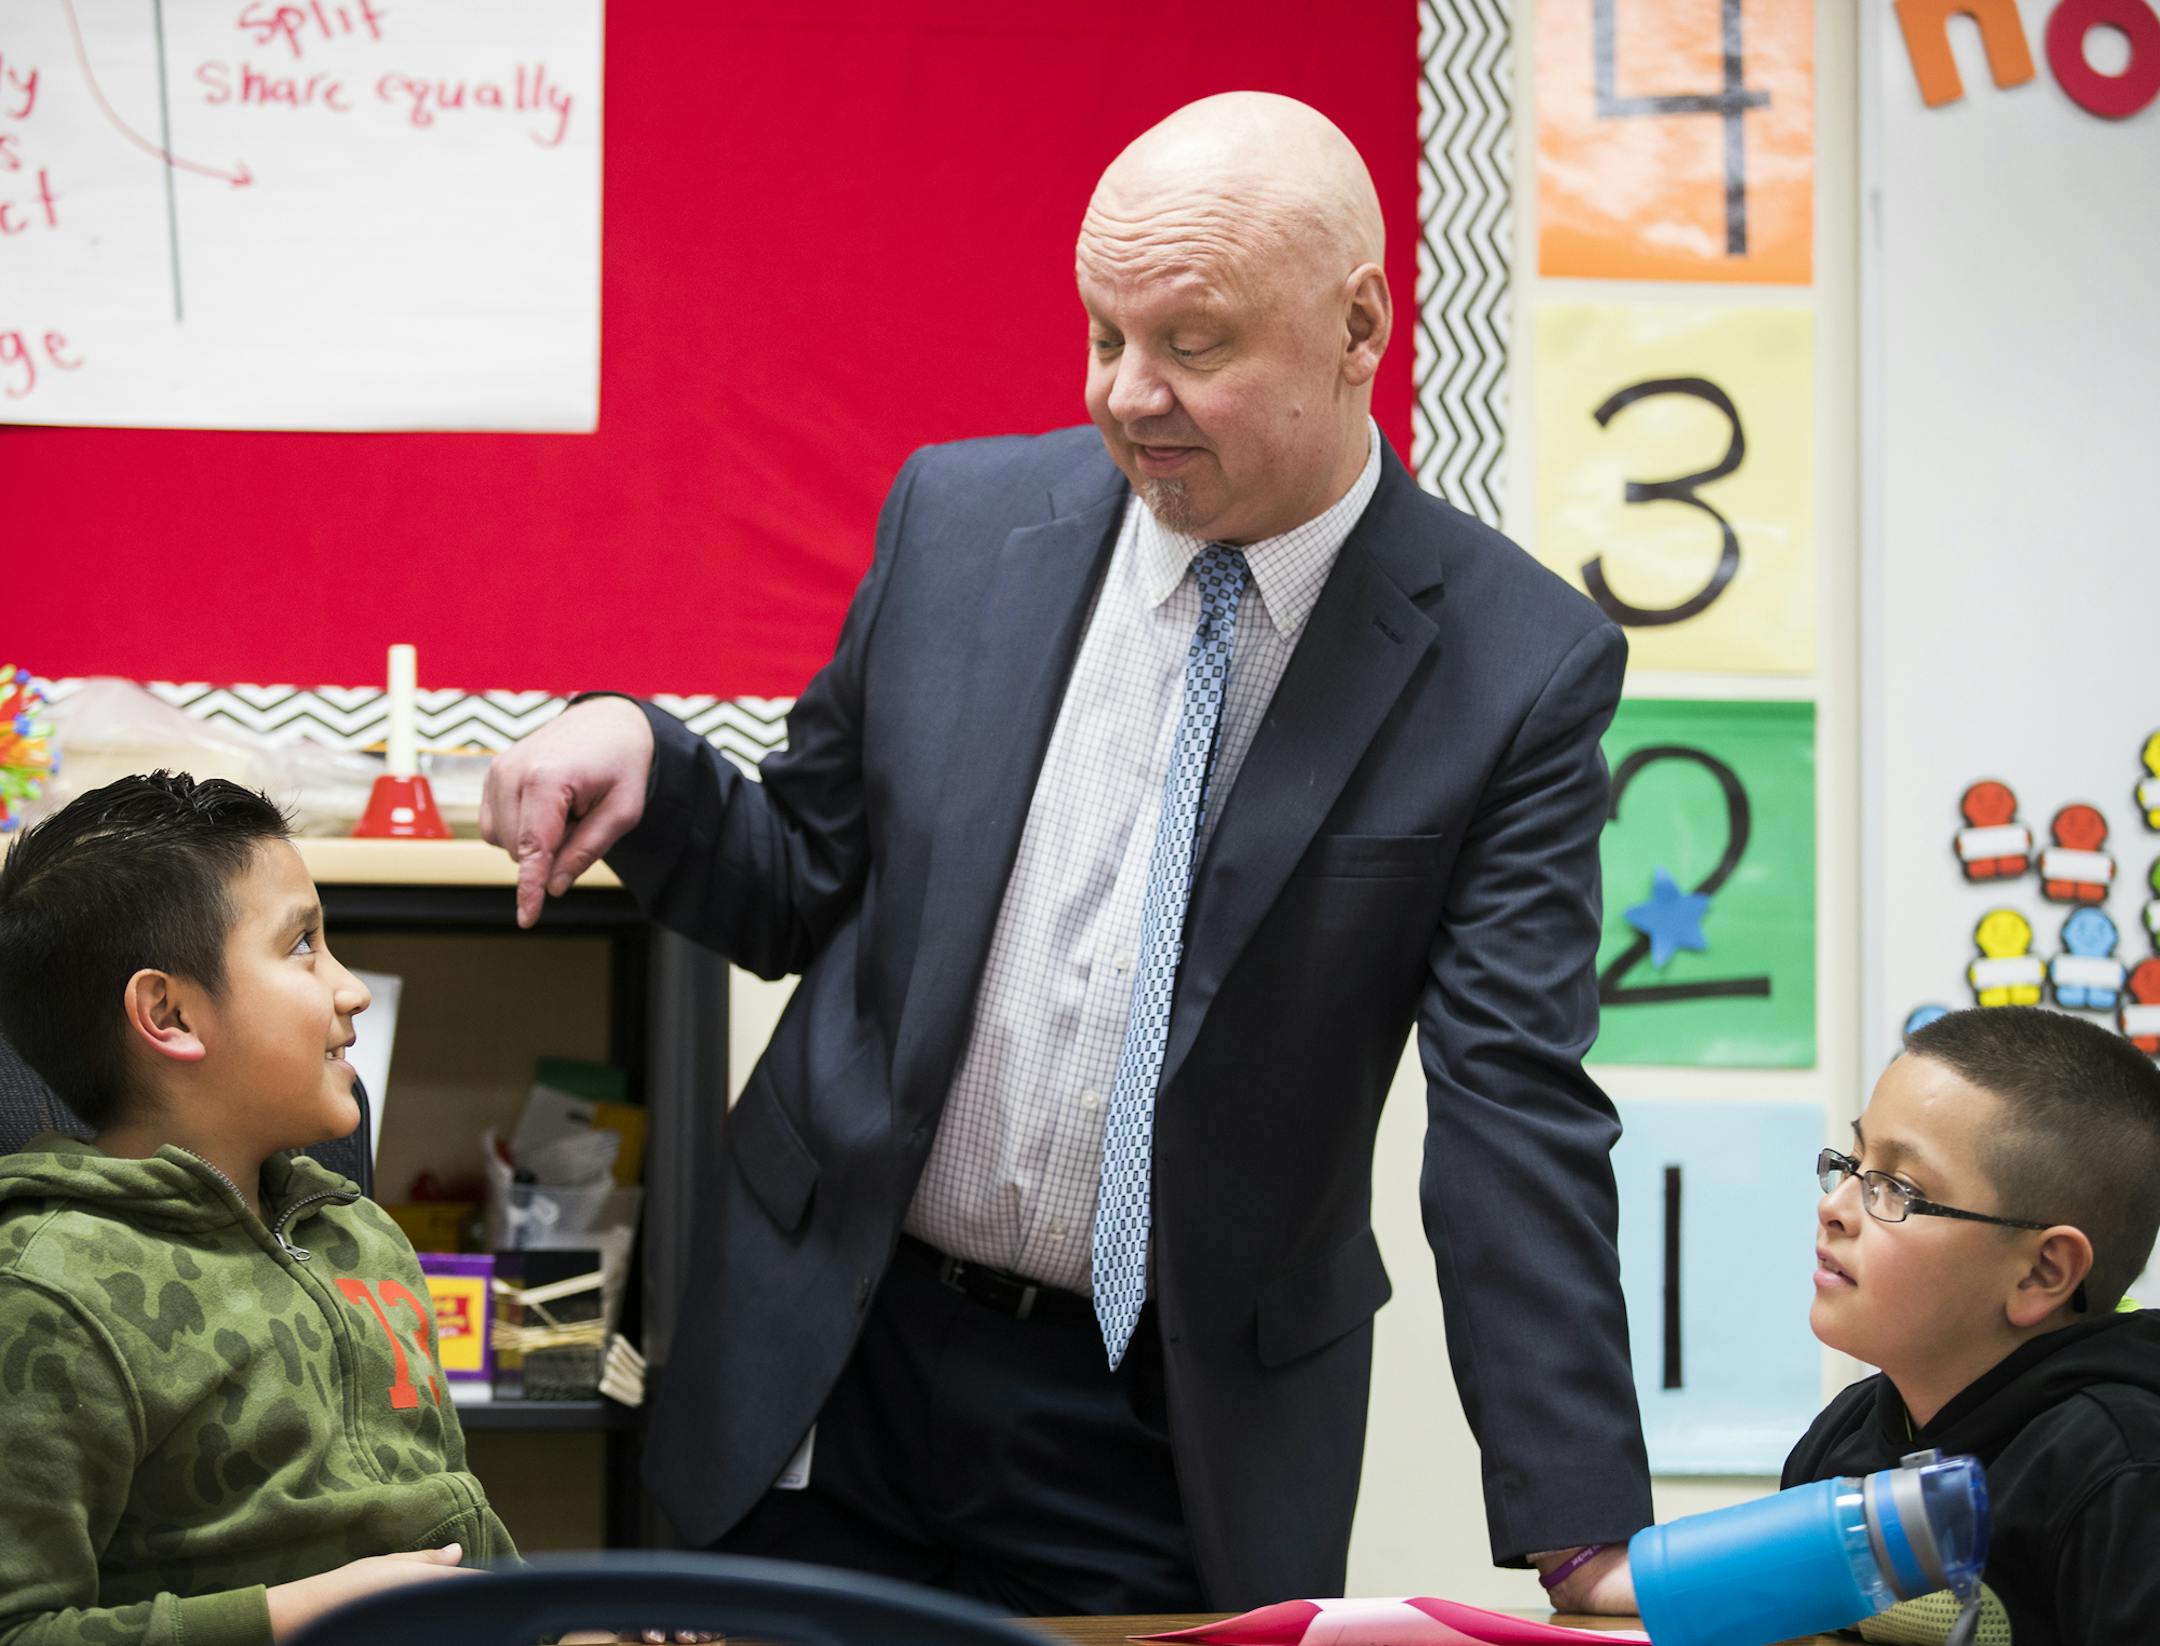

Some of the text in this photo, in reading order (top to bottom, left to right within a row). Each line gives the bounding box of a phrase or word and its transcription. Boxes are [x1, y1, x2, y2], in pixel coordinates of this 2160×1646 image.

[376, 63, 573, 147] equally
[1592, 0, 1771, 258] 4
[1580, 375, 1746, 628] 3
[1599, 742, 1772, 1006] 2
[1662, 1164, 1683, 1391] 1
